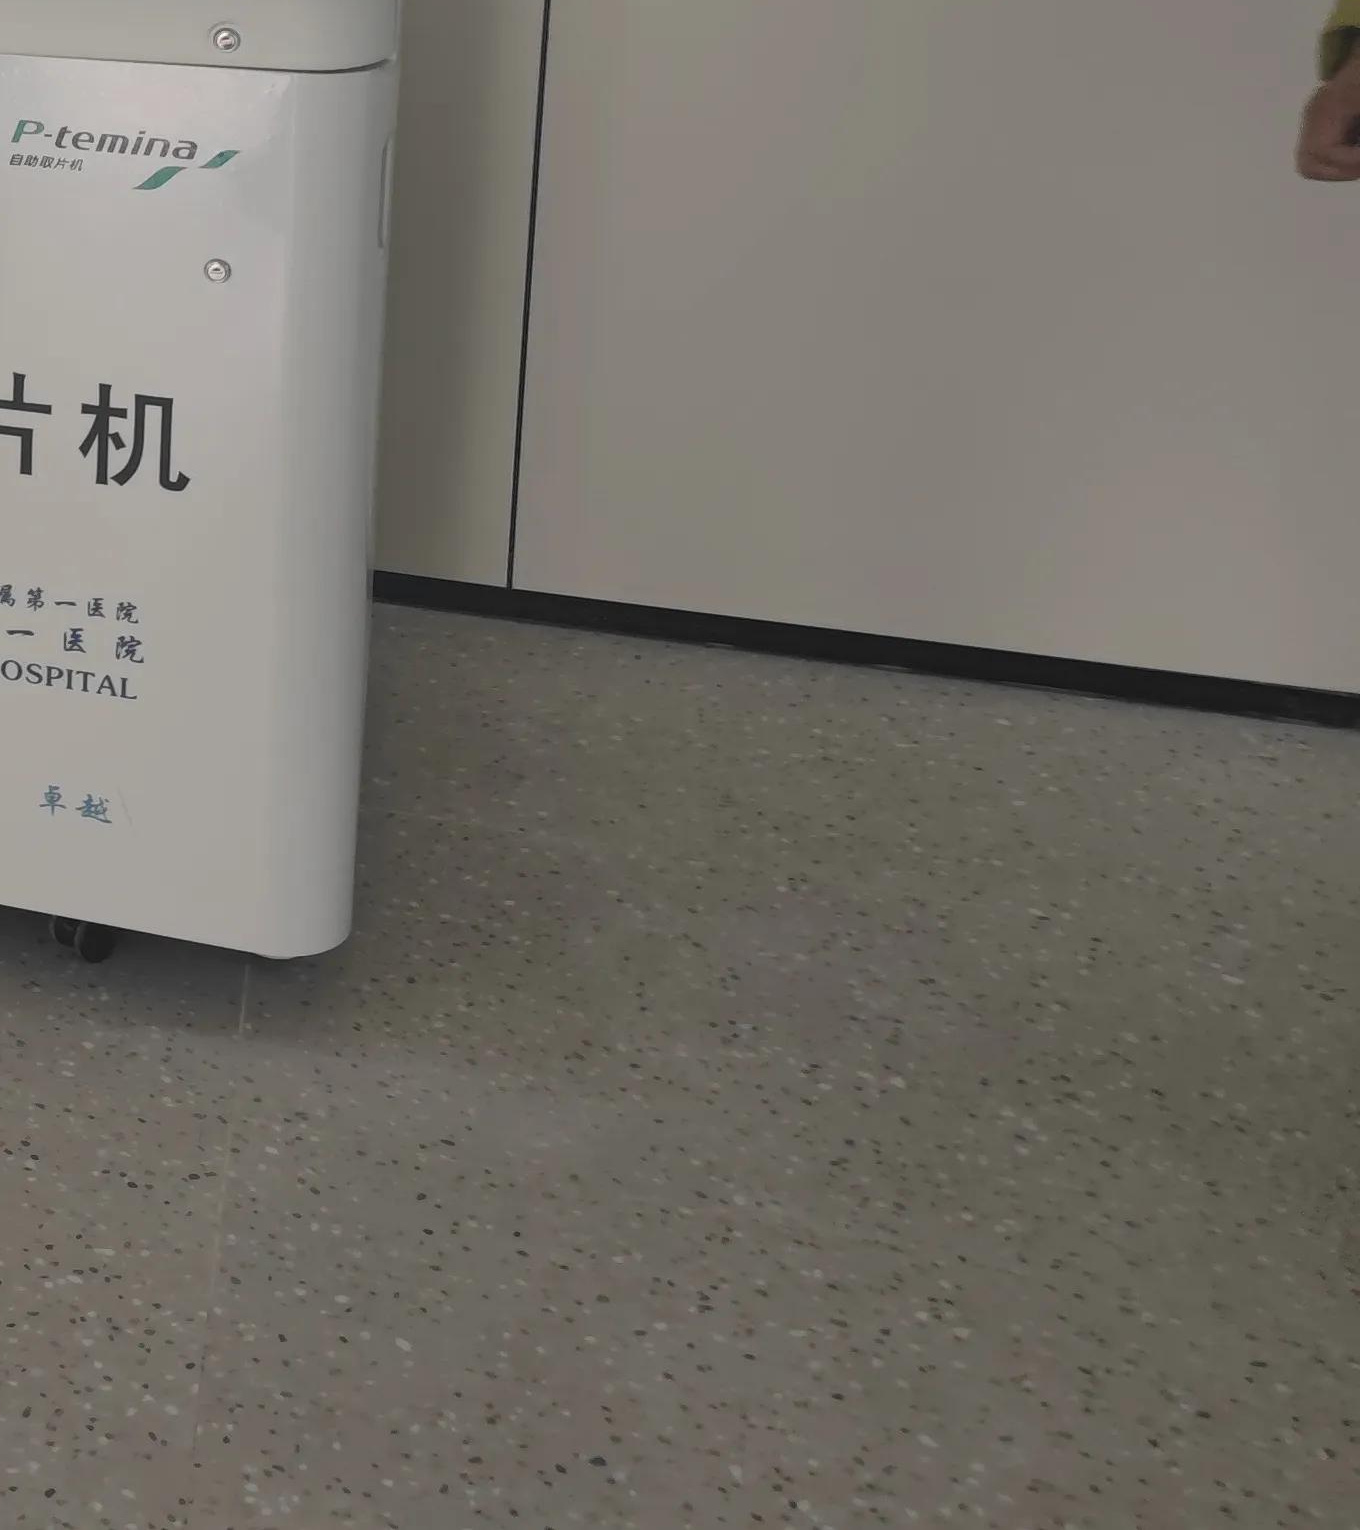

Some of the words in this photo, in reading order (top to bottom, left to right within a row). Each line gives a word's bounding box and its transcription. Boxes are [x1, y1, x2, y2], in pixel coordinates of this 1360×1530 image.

[10, 119, 199, 160] P-temina
[9, 153, 84, 172] 自助取片机
[38, 785, 114, 824] 卓越
